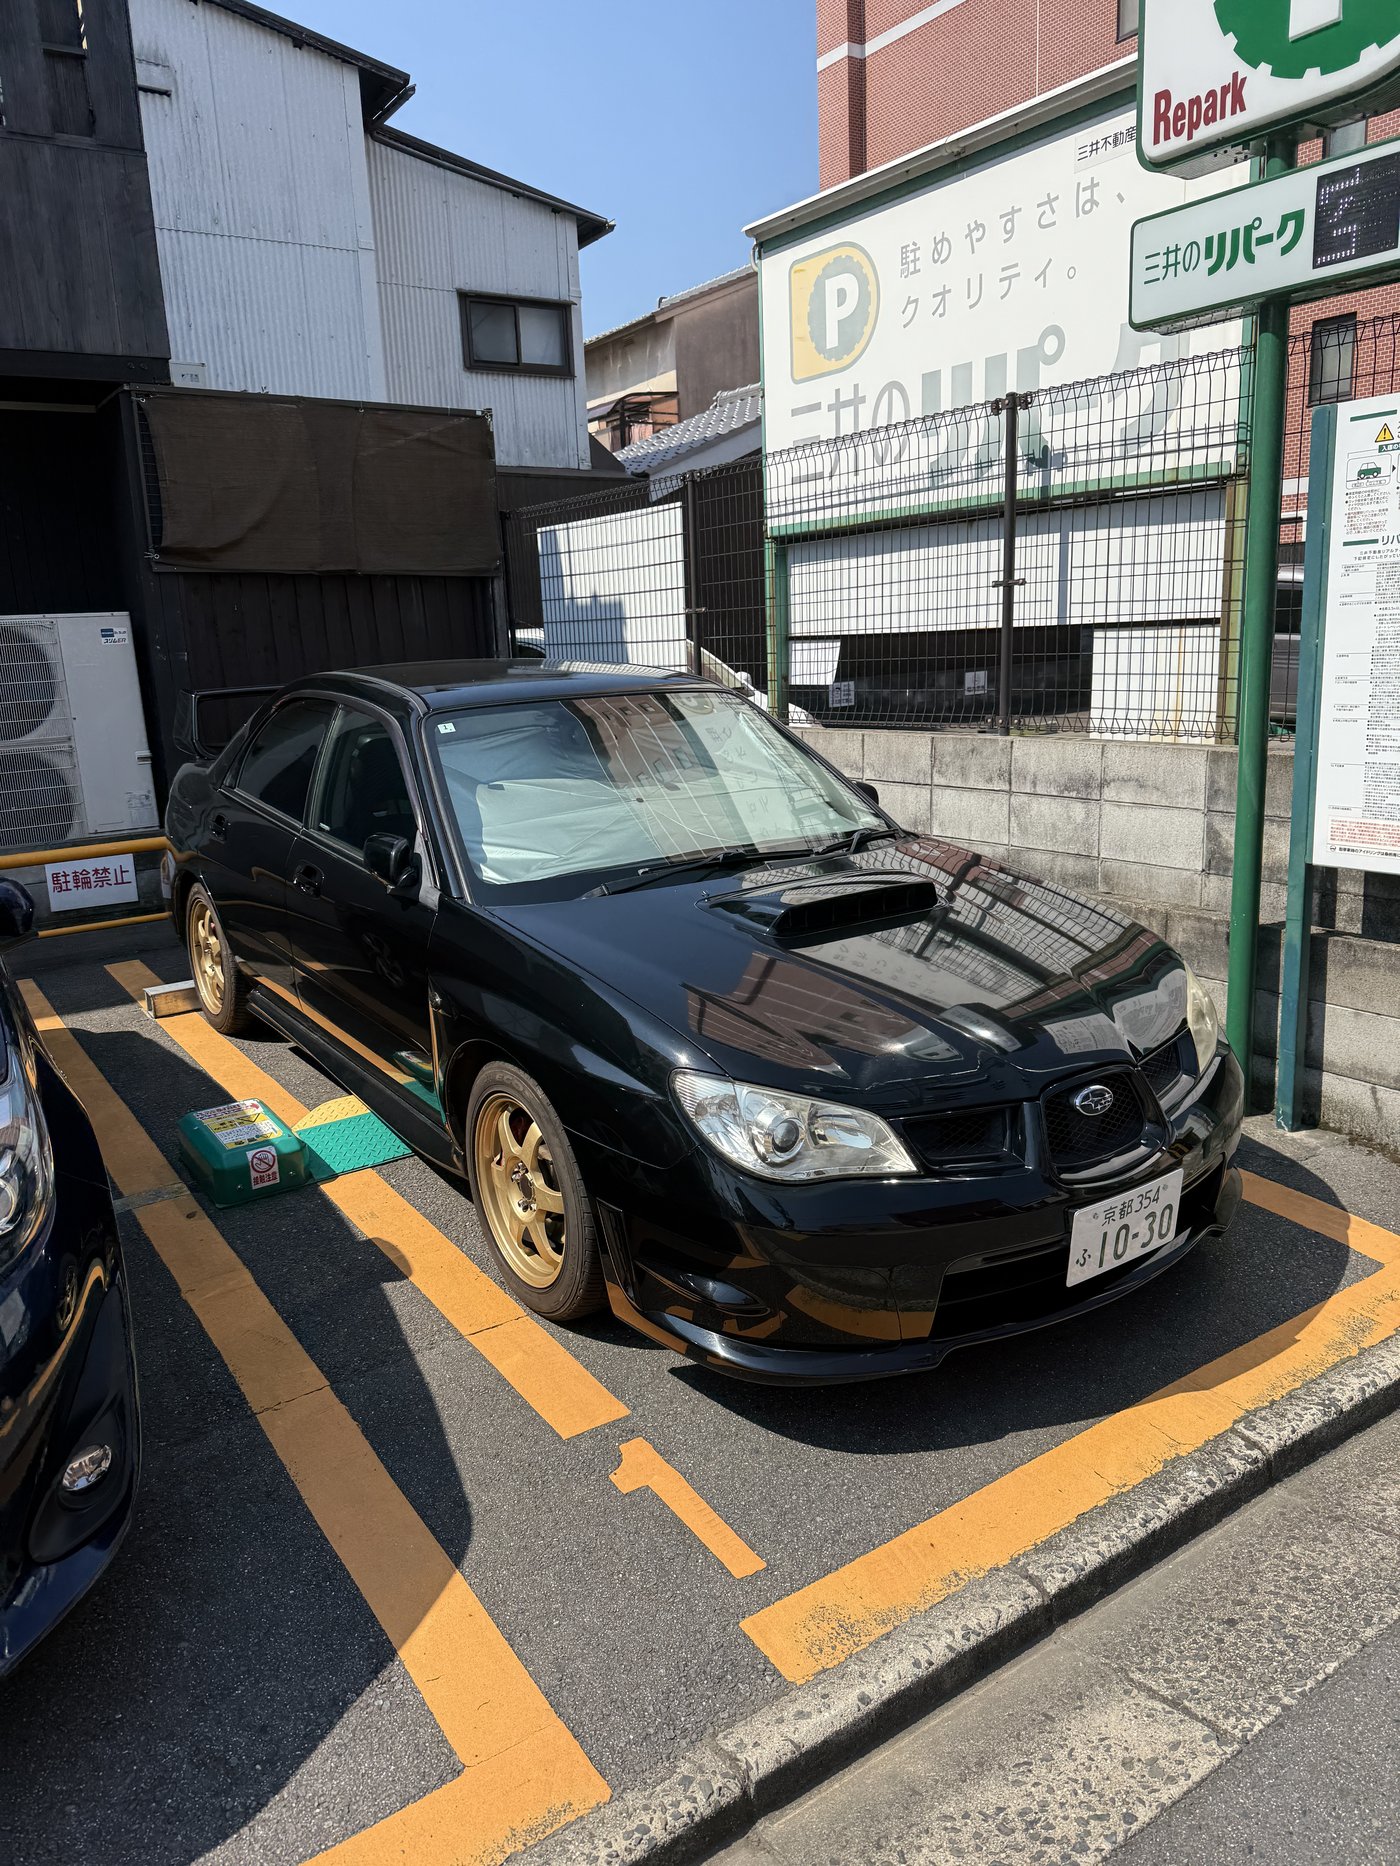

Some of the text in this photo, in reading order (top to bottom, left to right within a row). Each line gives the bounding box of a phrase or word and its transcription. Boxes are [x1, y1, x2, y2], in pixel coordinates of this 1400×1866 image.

[1152, 71, 1248, 146] Repark
[900, 177, 1126, 279] 駐めやすさは、
[1144, 208, 1306, 285] 三井のリパーク
[824, 272, 859, 350] P
[901, 258, 1077, 329] クオリティ。
[51, 864, 132, 893] 駐輪禁止
[1075, 1203, 1174, 1269] ふ 10-30
[608, 1436, 768, 1580] 1
